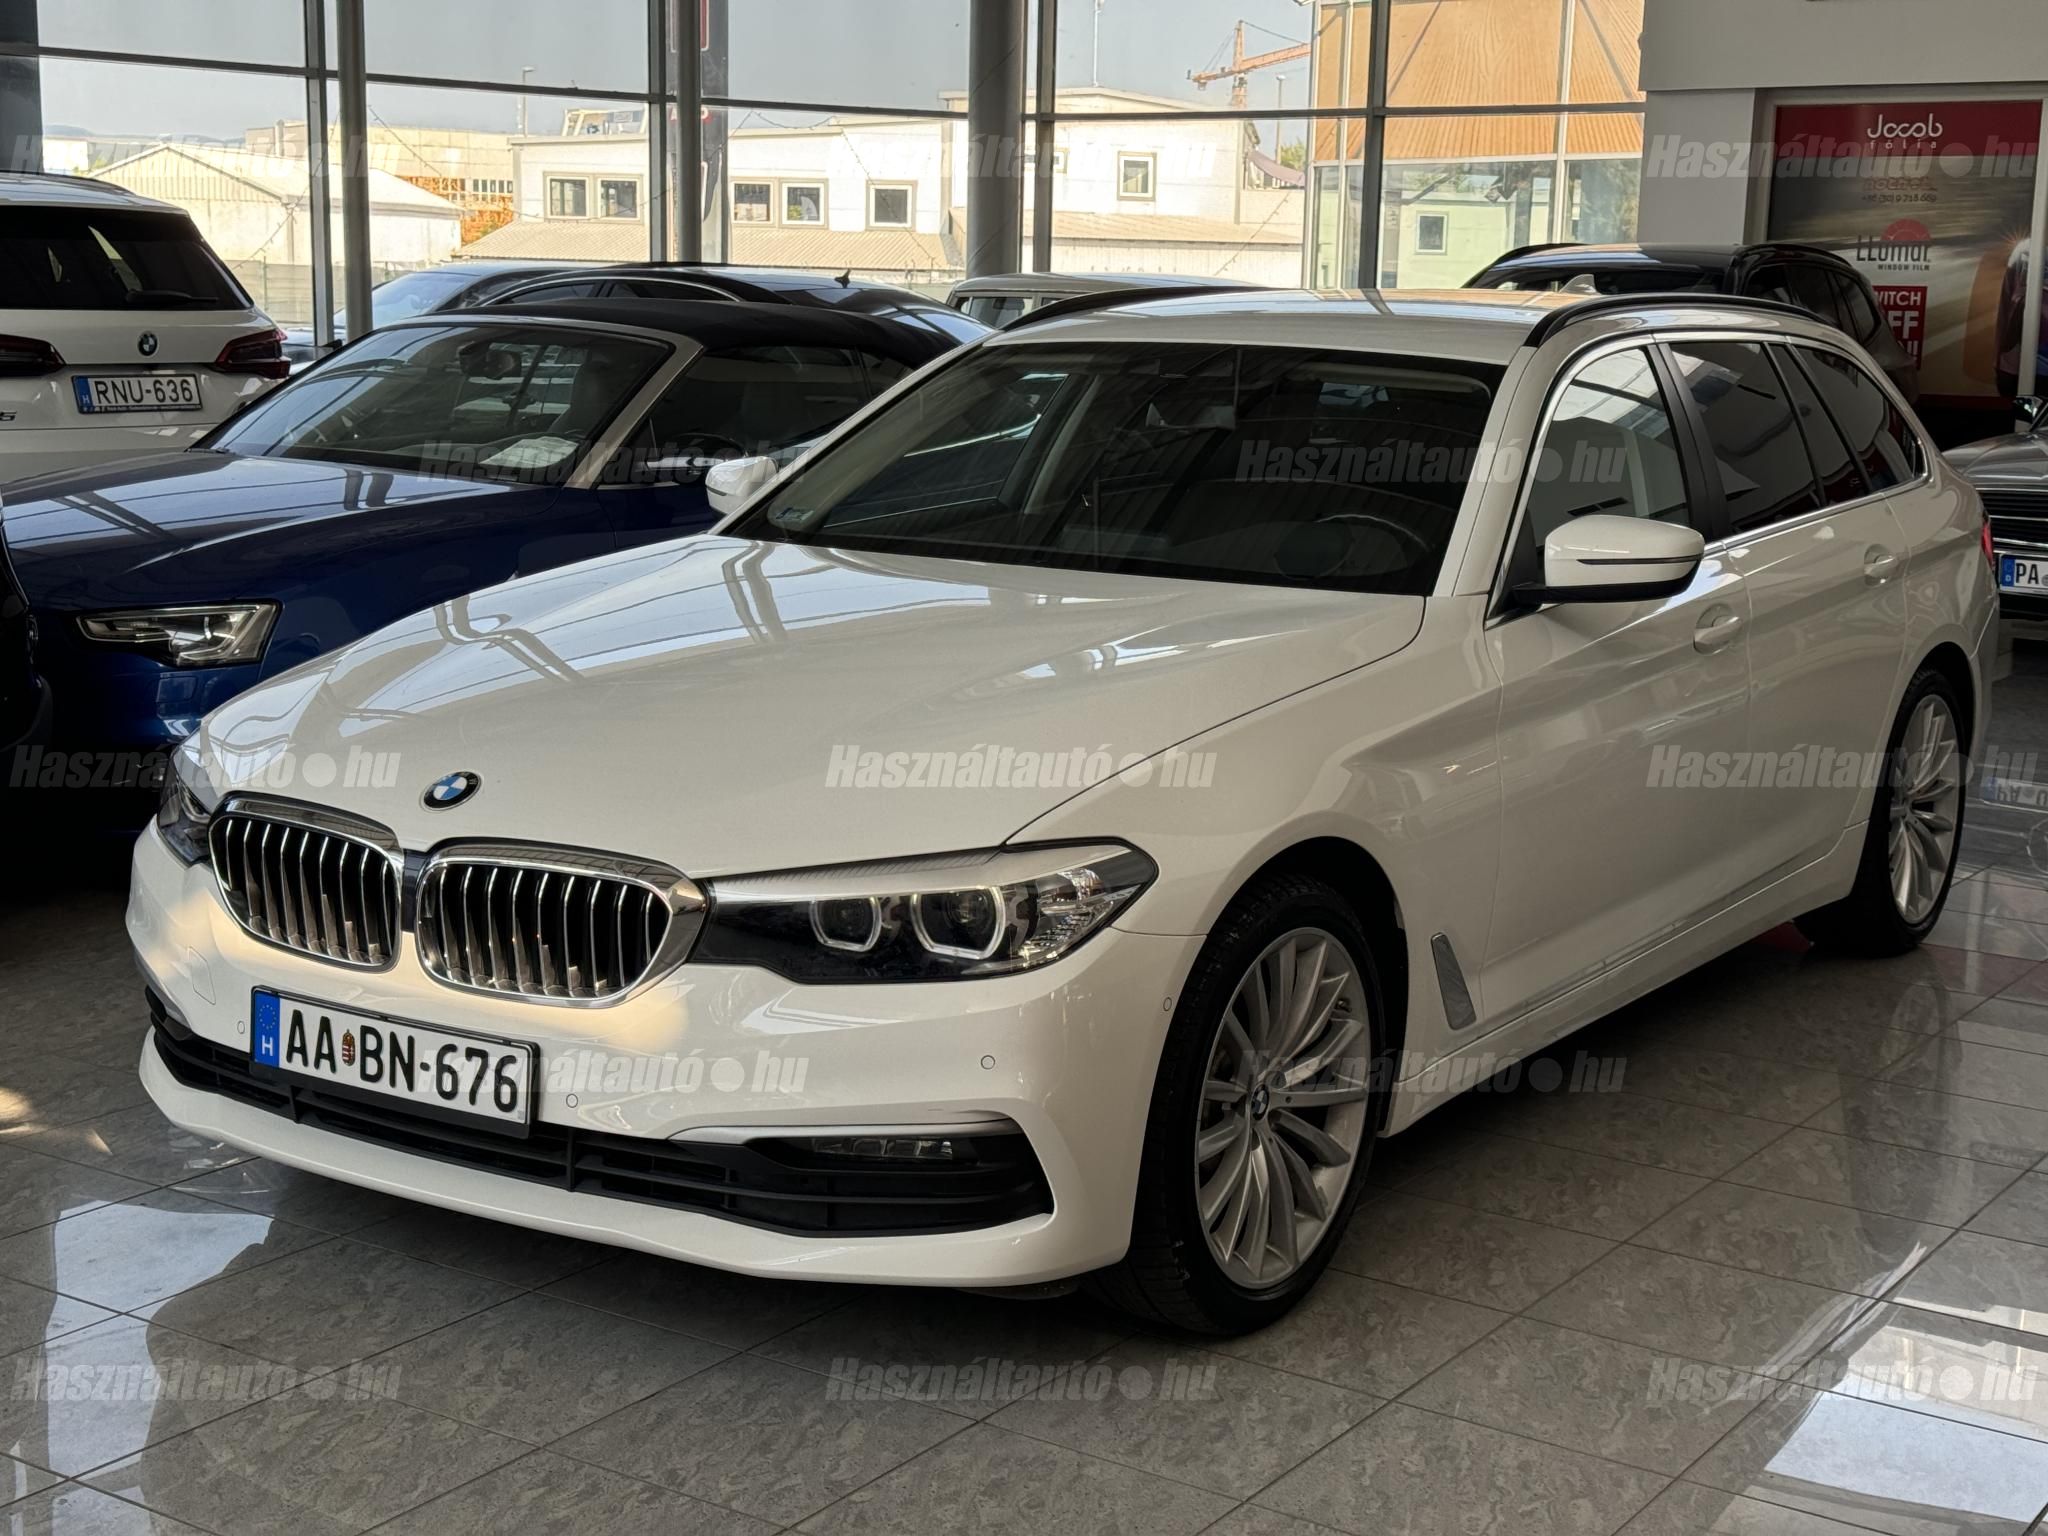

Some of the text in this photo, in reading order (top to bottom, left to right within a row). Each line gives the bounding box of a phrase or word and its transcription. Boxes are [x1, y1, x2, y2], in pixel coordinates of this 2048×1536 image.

[1912, 263, 1930, 271] FILM
[95, 379, 194, 404] RNU-636
[2015, 563, 2040, 584] PA
[261, 1034, 274, 1058] H
[285, 1009, 518, 1113] AA BN-676
